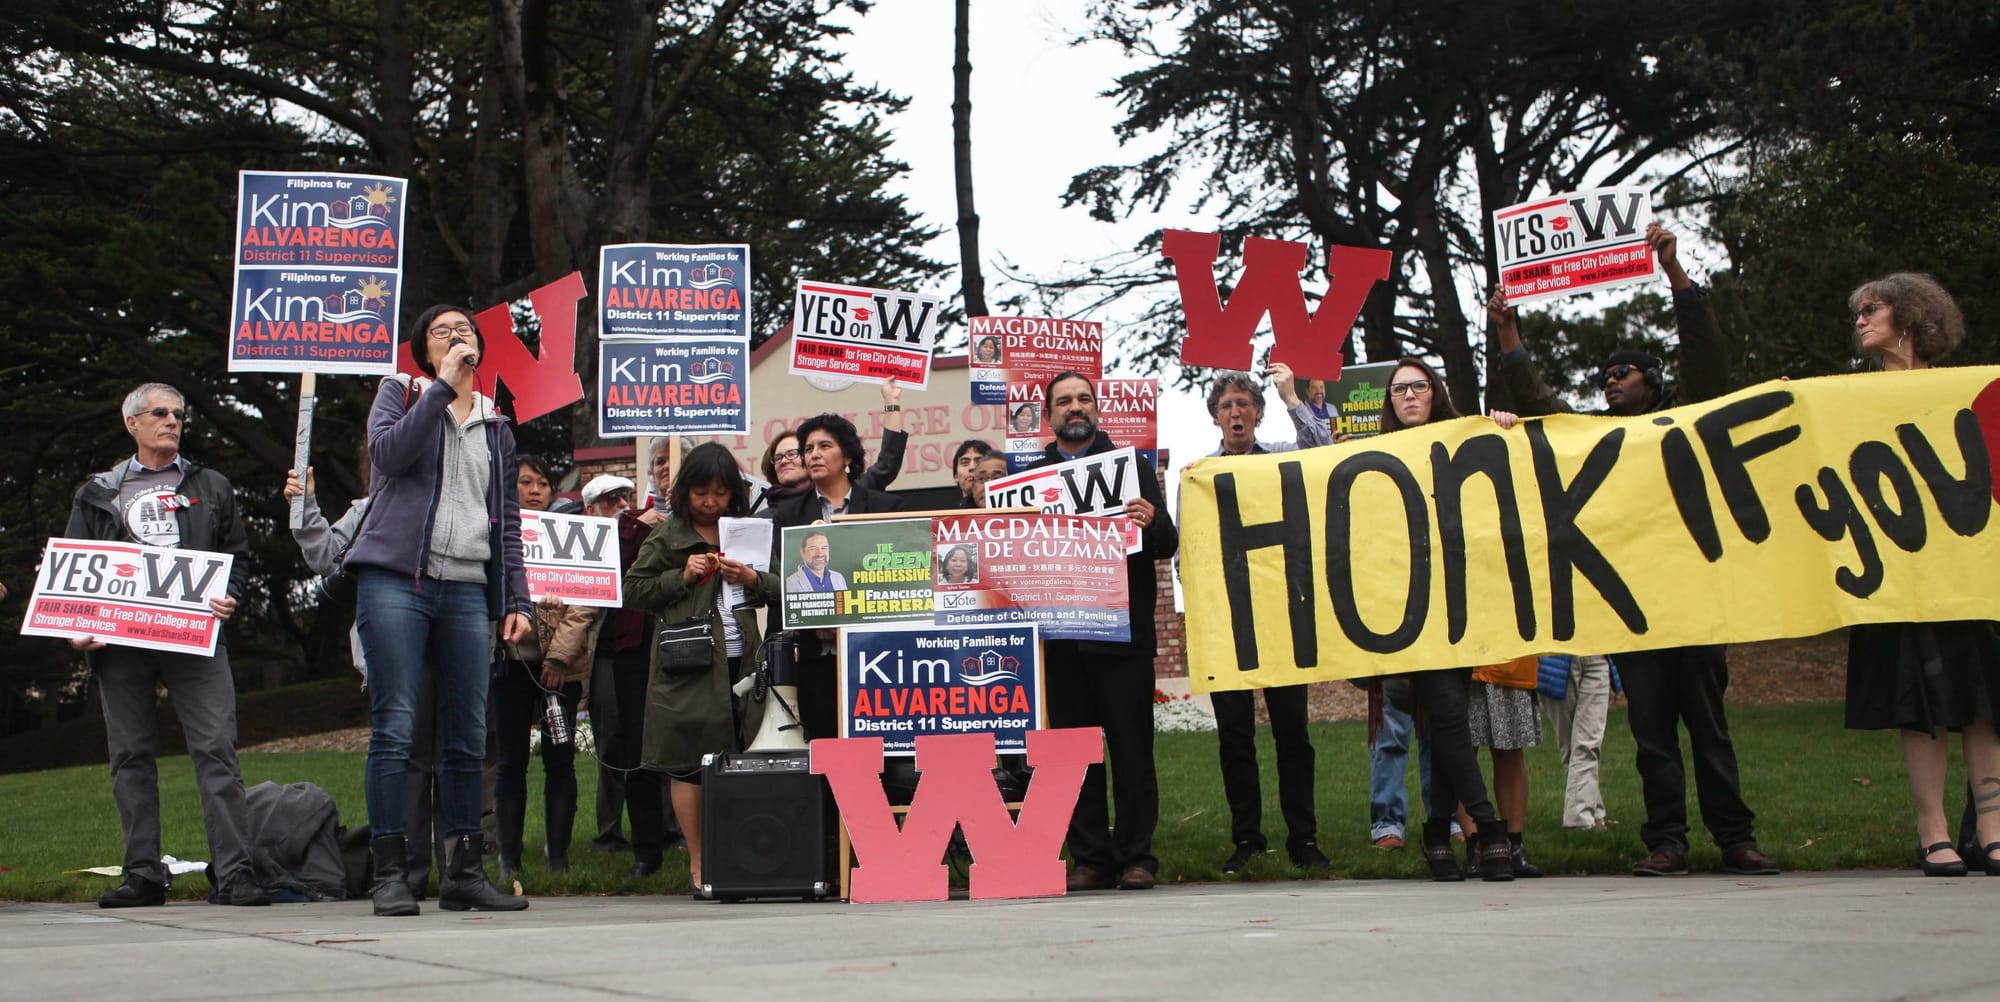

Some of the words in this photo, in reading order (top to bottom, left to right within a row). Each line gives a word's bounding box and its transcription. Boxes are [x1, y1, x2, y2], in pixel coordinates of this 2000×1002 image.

[287, 179, 333, 190] Filipinos
[336, 180, 352, 189] for
[251, 194, 329, 227] Kim
[1498, 214, 1546, 261] YES
[1551, 231, 1575, 250] on
[1570, 193, 1643, 242] W
[243, 227, 396, 249] ALVARENGA
[244, 250, 295, 261] District
[300, 251, 310, 261] 11
[315, 250, 394, 264] Supervisor
[656, 252, 689, 263] Working
[692, 252, 725, 261] Families
[727, 252, 739, 261] for
[1505, 271, 1521, 283] FAIR
[1523, 266, 1550, 279] SHARE
[1552, 264, 1562, 275] for
[1564, 261, 1580, 273] Free
[1582, 258, 1597, 270] City
[1599, 254, 1629, 267] College
[1630, 248, 1645, 260] and
[280, 272, 327, 283] Filipinos
[330, 273, 346, 283] for
[611, 260, 682, 286] Kim
[1505, 281, 1535, 296] Stronger
[1537, 275, 1570, 289] Services
[244, 287, 323, 321] Kim
[607, 287, 741, 310] ALVARENGA
[1161, 229, 1393, 382] W
[607, 309, 653, 320] District
[656, 311, 669, 320] 11
[674, 310, 740, 322] Supervisor
[801, 294, 847, 336] YES
[850, 322, 872, 339] on
[874, 296, 933, 343] W
[236, 321, 391, 344] ALVARENGA
[973, 319, 1100, 339] MAGDALENA
[236, 344, 288, 356] District
[294, 345, 304, 355] 11
[310, 346, 388, 359] Supervisor
[656, 348, 689, 357] Working
[691, 346, 725, 356] Families
[727, 346, 739, 355] for
[1006, 336, 1027, 348] DE
[1033, 336, 1100, 352] GUZMAN
[797, 355, 829, 369] Stronger
[829, 358, 860, 372] Services
[799, 343, 816, 355] FAIR
[818, 345, 844, 358] SHARE
[846, 350, 855, 359] for
[857, 351, 871, 361] Free
[873, 351, 886, 363] City
[888, 353, 910, 367] College
[911, 359, 923, 368] and
[611, 357, 682, 382] Kim
[606, 383, 741, 406] ALVARENGA
[1009, 381, 1154, 401] MALENA
[1349, 388, 1386, 401] GREE
[607, 407, 652, 418] District
[656, 407, 669, 417] 11
[674, 407, 740, 418] Supervisor
[1097, 399, 1155, 413] ZMAN
[1342, 400, 1384, 412] PROGRESS
[763, 405, 951, 447] CLEGE
[1337, 416, 1380, 433] HERR
[1352, 415, 1380, 423] FRANC
[1060, 456, 1128, 514] W
[522, 543, 543, 559] on
[541, 518, 611, 561] W
[937, 518, 1122, 542] MAGDALENA
[876, 543, 893, 553] THE
[985, 541, 1013, 559] DE
[1024, 540, 1123, 560] GUZMAN
[863, 551, 931, 571] GREEN
[46, 551, 109, 593] YES
[108, 578, 136, 597] on
[143, 552, 224, 602] W
[530, 570, 546, 581] Free
[548, 571, 563, 583] City
[565, 574, 595, 585] College
[596, 576, 610, 585] and
[853, 568, 931, 584] PROGRESSIVE
[1020, 577, 1087, 587] votemagdalena.com
[799, 591, 834, 600] SUPERVISOR
[844, 590, 934, 614] HERRERA
[866, 589, 932, 600] FRANCISCO
[1011, 592, 1040, 602] District
[1044, 592, 1052, 601] 11
[1056, 592, 1097, 603] Supervisor
[801, 608, 828, 617] DISTRICT
[829, 607, 836, 615] 11
[802, 600, 835, 609] FRANCISCO
[34, 613, 74, 627] Stronger
[75, 616, 117, 632] Services
[38, 602, 60, 614] FAIR
[62, 603, 96, 616] SHARE
[99, 607, 112, 618] for
[113, 608, 133, 621] Free
[135, 610, 153, 624] City
[154, 612, 188, 629] College
[189, 618, 207, 630] and
[947, 614, 993, 623] Defender
[997, 612, 1007, 621] of
[1010, 611, 1051, 620] Children
[1056, 610, 1075, 619] and
[1078, 610, 1118, 621] Families
[127, 625, 204, 644] www.FairShareSF.org
[916, 637, 960, 650] Working
[963, 635, 1008, 648] Families
[1010, 635, 1025, 646] for
[859, 650, 950, 684] Kim
[854, 685, 1030, 717] ALVARENGA
[855, 718, 913, 731] District
[918, 717, 935, 730] 11
[941, 716, 1029, 732] Supervisor
[810, 727, 1104, 904] W
